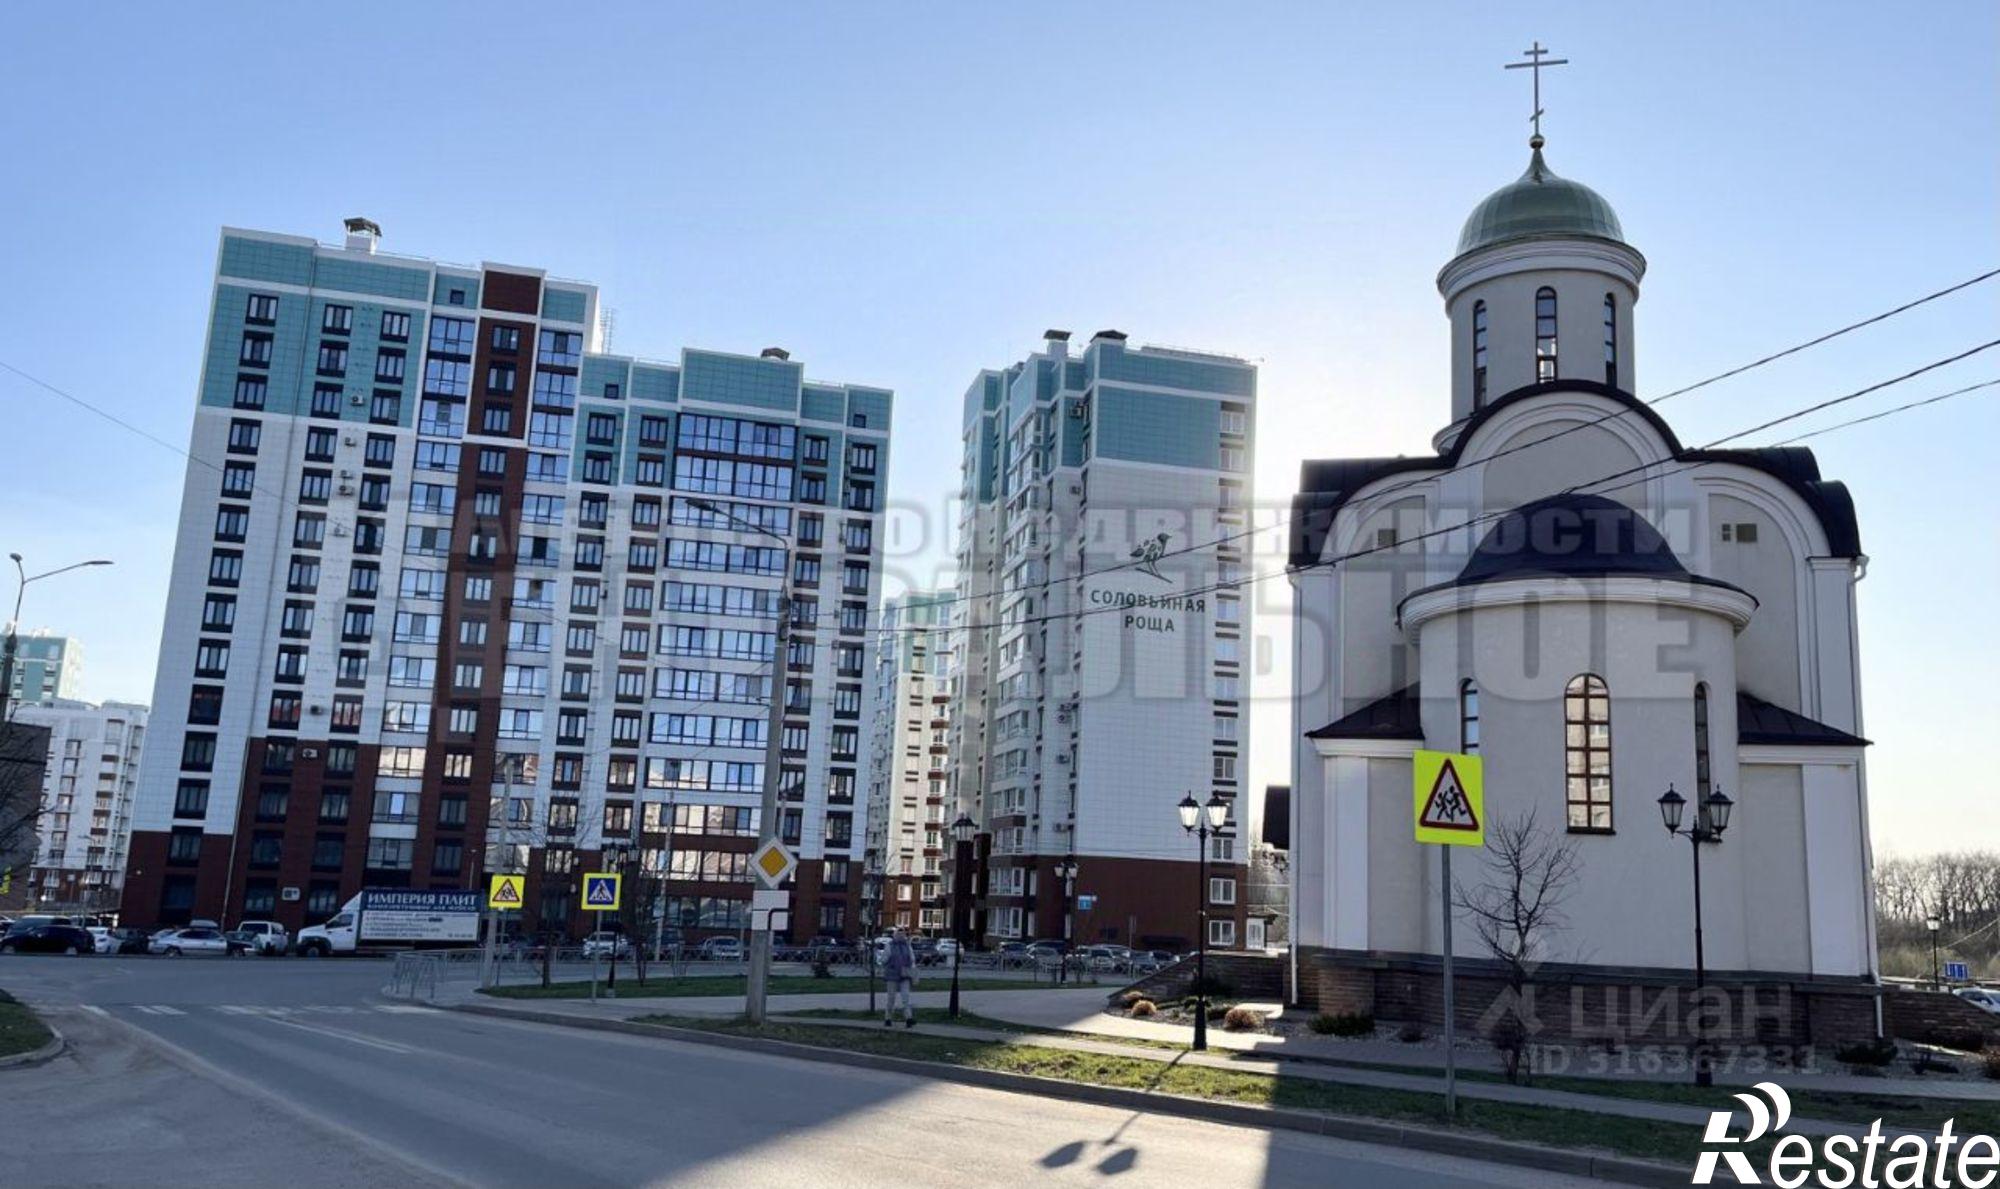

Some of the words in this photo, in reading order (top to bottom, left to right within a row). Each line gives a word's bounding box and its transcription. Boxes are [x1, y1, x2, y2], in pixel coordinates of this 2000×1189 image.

[1124, 615, 1175, 633] РОЩА
[368, 893, 436, 905] ИМПЕРИЯ
[440, 894, 478, 906] ПЛИТ
